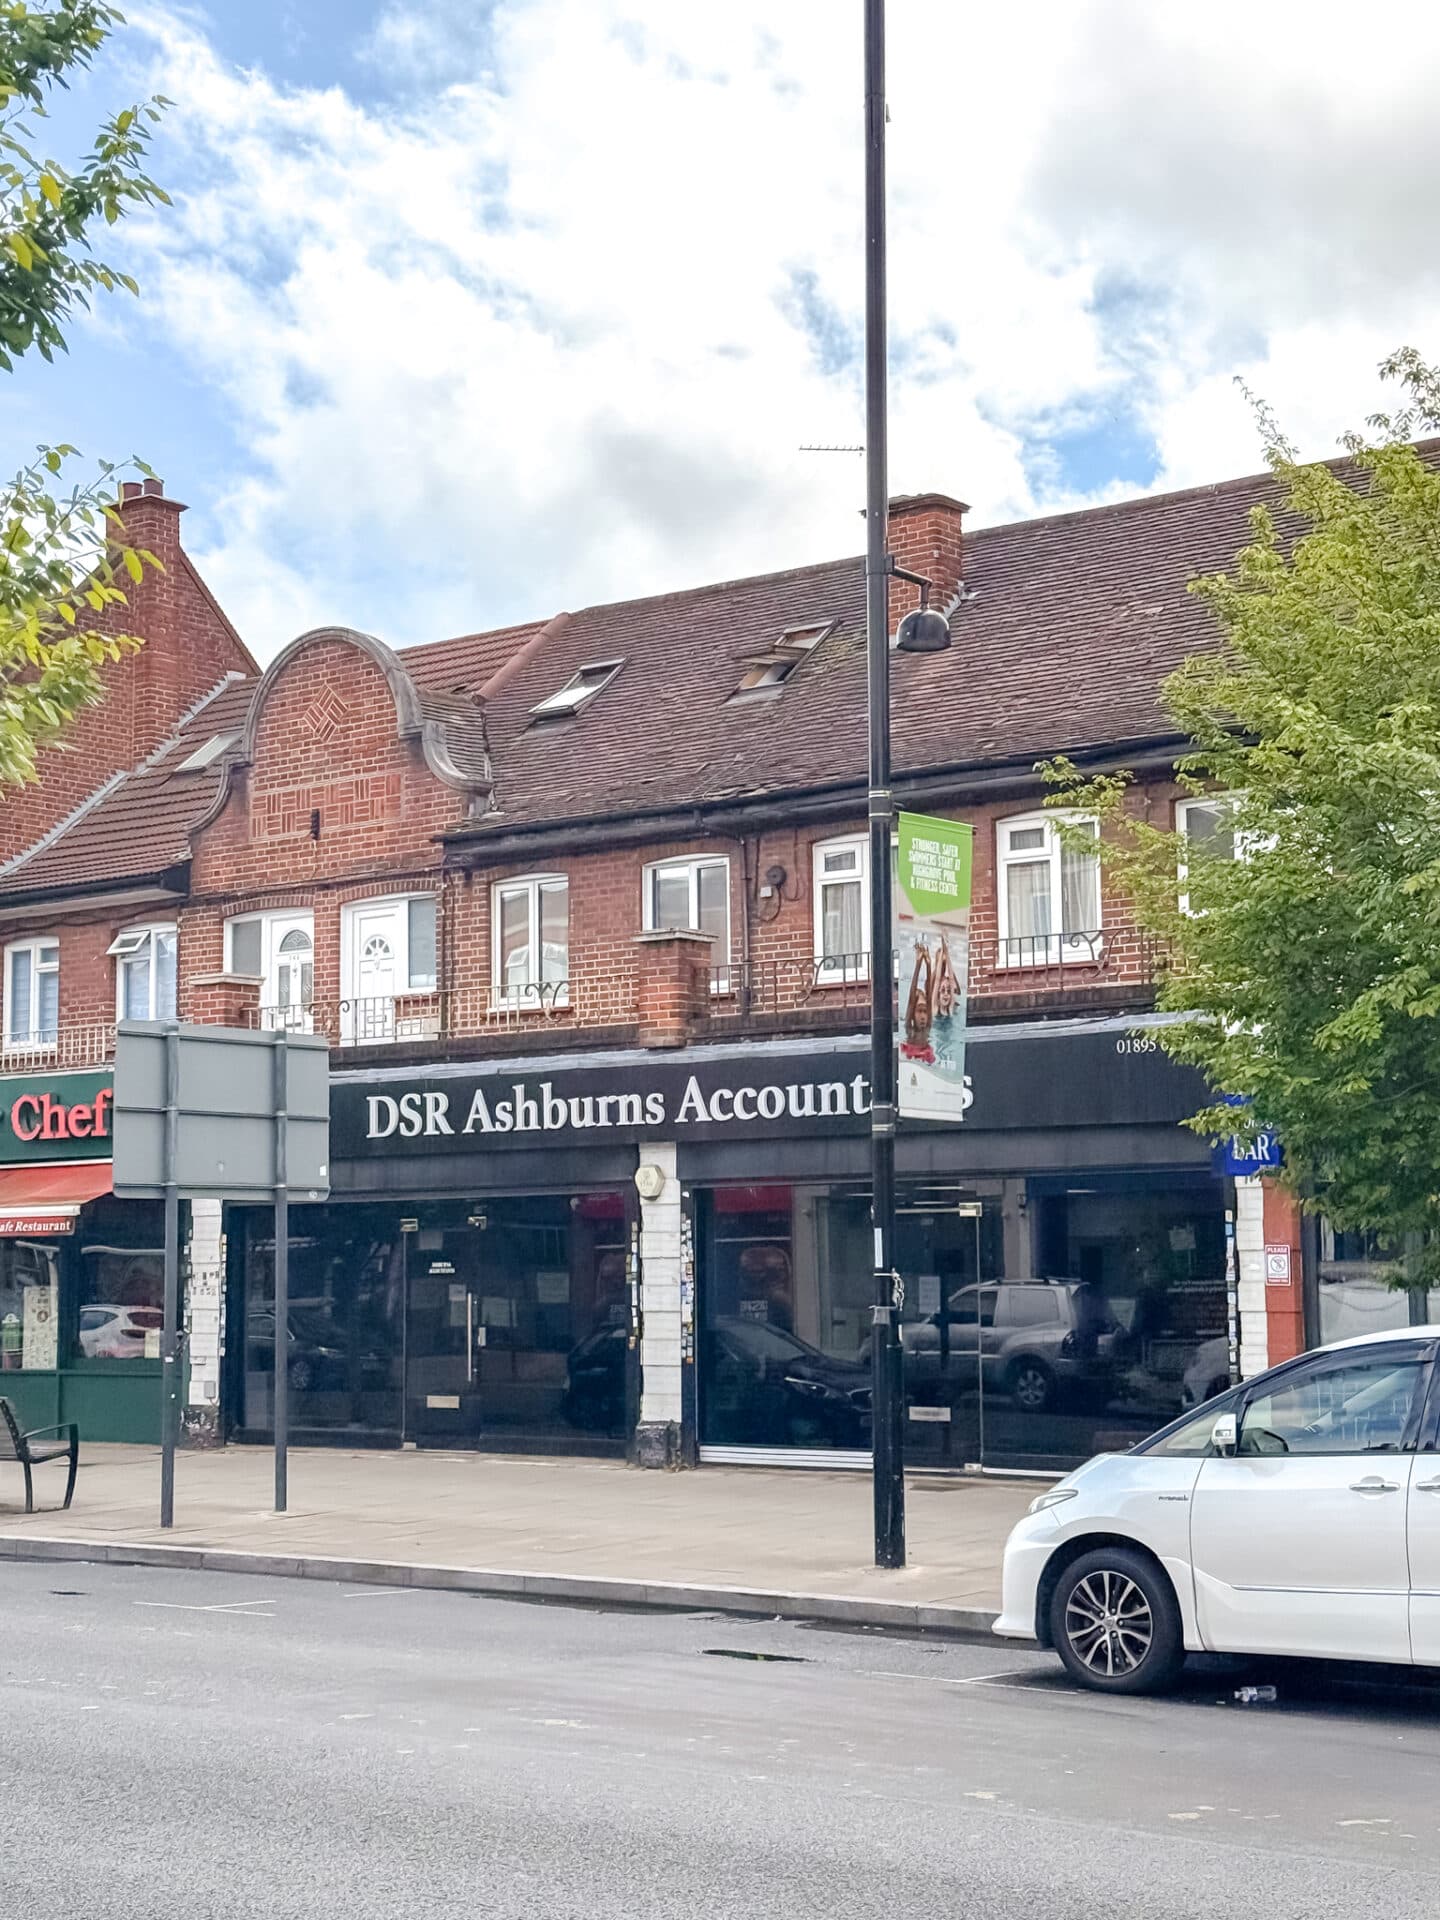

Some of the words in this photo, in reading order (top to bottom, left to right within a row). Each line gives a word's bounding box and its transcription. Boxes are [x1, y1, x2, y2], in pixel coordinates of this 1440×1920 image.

[1116, 1038, 1157, 1054] 01895
[11, 1088, 113, 1141] Chef
[366, 1092, 455, 1139] DSR
[462, 1082, 666, 1134] Ashburns
[674, 1075, 974, 1123] Accounts
[1232, 1133, 1271, 1161] BAR
[15, 1220, 71, 1232] Restaurant
